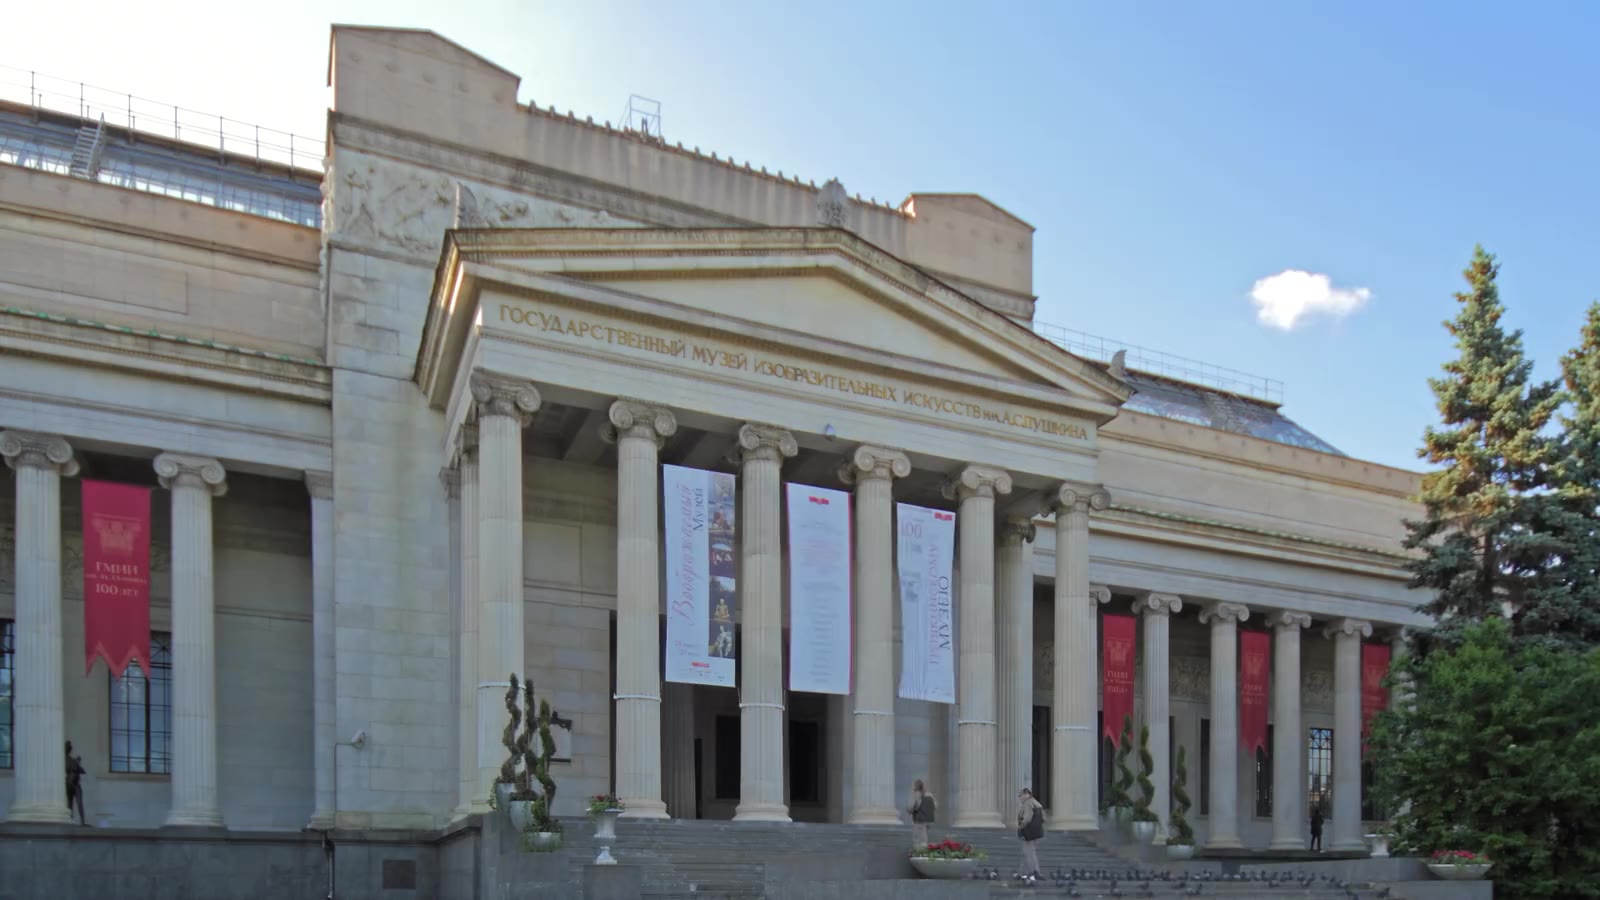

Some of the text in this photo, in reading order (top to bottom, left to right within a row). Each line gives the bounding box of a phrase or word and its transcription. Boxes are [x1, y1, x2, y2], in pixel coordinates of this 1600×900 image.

[499, 303, 687, 359] ГОСУДАРСТВЕННЫЙ
[692, 344, 748, 372] МУЗЕЙ
[753, 357, 897, 402] ИЗОБРАЗИТЕЛЬНЫХ
[902, 390, 981, 419] ИСКУССТВ
[96, 583, 118, 595] 100
[938, 575, 950, 650] МУЗЕЮ
